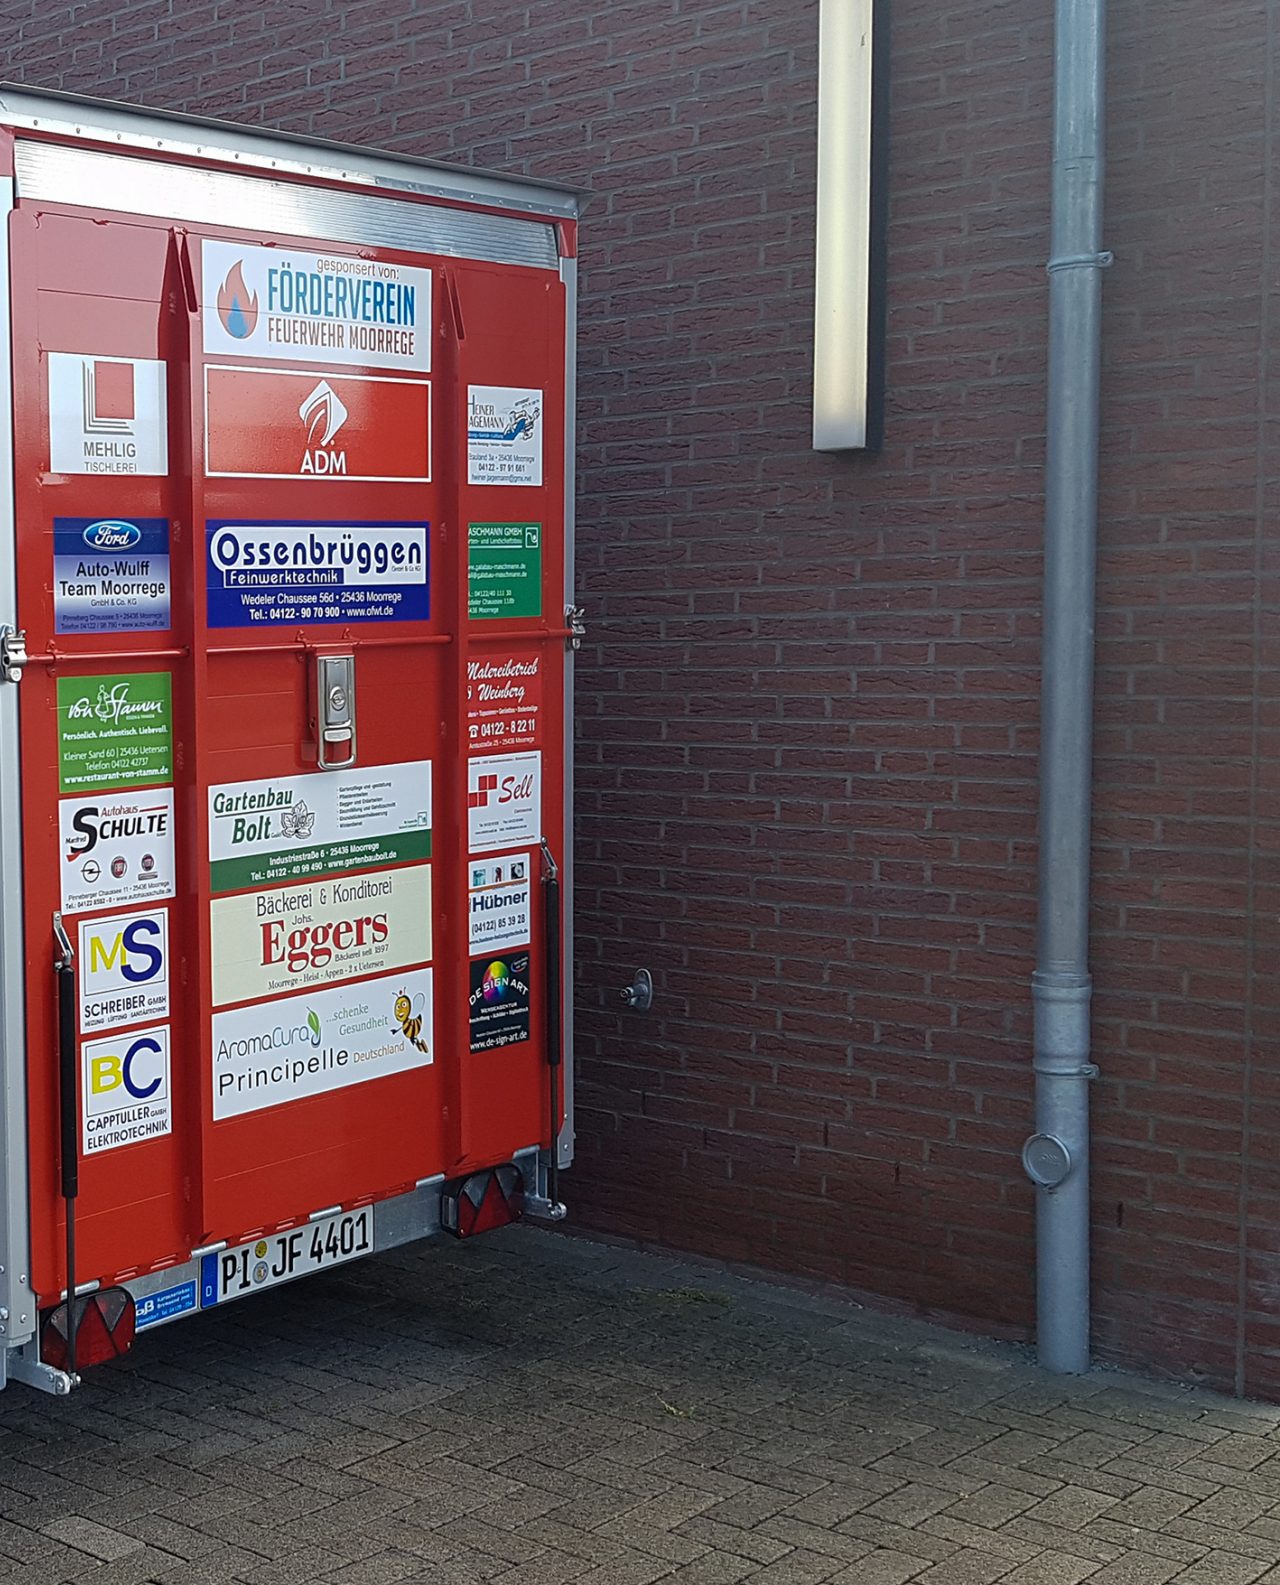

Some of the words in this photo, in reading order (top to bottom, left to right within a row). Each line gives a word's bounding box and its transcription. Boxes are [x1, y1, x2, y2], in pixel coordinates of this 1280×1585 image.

[317, 258, 376, 276] gesponsert
[377, 267, 400, 279] von:
[268, 262, 415, 327] FÖRDERVEREIN
[268, 318, 344, 348] FEUERWEHR
[349, 325, 414, 355] MOORREGE
[469, 416, 504, 428] AGEMANN
[84, 442, 136, 457] MEHLIG
[85, 462, 136, 472] TISCHLEREI
[300, 449, 346, 474] ADM
[95, 525, 130, 545] Ford
[468, 528, 503, 536] ASCHMANN
[217, 533, 421, 574] Ossenbrüggen
[76, 561, 150, 577] Auto-Wulff
[230, 569, 338, 585] Feinwerktechnik
[59, 581, 96, 596] Team
[101, 581, 165, 597] Moorrege
[241, 594, 275, 605] Wedeler
[277, 593, 317, 604] Chaussee
[319, 592, 334, 603] 56d
[341, 592, 364, 602] 25436
[367, 592, 402, 602] Moorrege
[249, 610, 268, 620] Tel.:
[270, 609, 295, 619] 04122
[314, 608, 323, 618] 70
[325, 607, 339, 617] 900
[478, 680, 525, 703] Weinberg
[481, 722, 504, 736] 04122
[511, 720, 515, 733] 8
[517, 720, 526, 732] 22
[529, 719, 535, 731] 11
[85, 761, 110, 771] Telefon
[498, 774, 533, 803] Sell
[214, 787, 293, 814] Gartenbau
[101, 806, 138, 817] Autohaus
[73, 807, 168, 854] SCHULTE
[232, 815, 271, 844] Bolt
[257, 888, 312, 917] Bäckerei
[320, 889, 327, 905] &
[333, 877, 392, 904] Konditorei
[473, 892, 527, 912] Hübner
[292, 916, 314, 926] Johs.
[91, 919, 162, 982] MS
[260, 913, 388, 973] Eggers
[325, 968, 343, 979] Appen
[510, 979, 528, 995] ART
[85, 994, 145, 1018] SCHREIBER
[339, 1016, 388, 1036] Gesundheit
[92, 1038, 162, 1098] BC
[219, 1048, 348, 1096] Principelle
[354, 1041, 404, 1064] Deutschland
[87, 1106, 150, 1132] CAPPTULLER
[88, 1119, 168, 1149] ELEKTROTECHNIK
[206, 1285, 212, 1297] D
[222, 1249, 250, 1295] PI
[272, 1232, 303, 1278] JF
[310, 1212, 369, 1263] 4401
